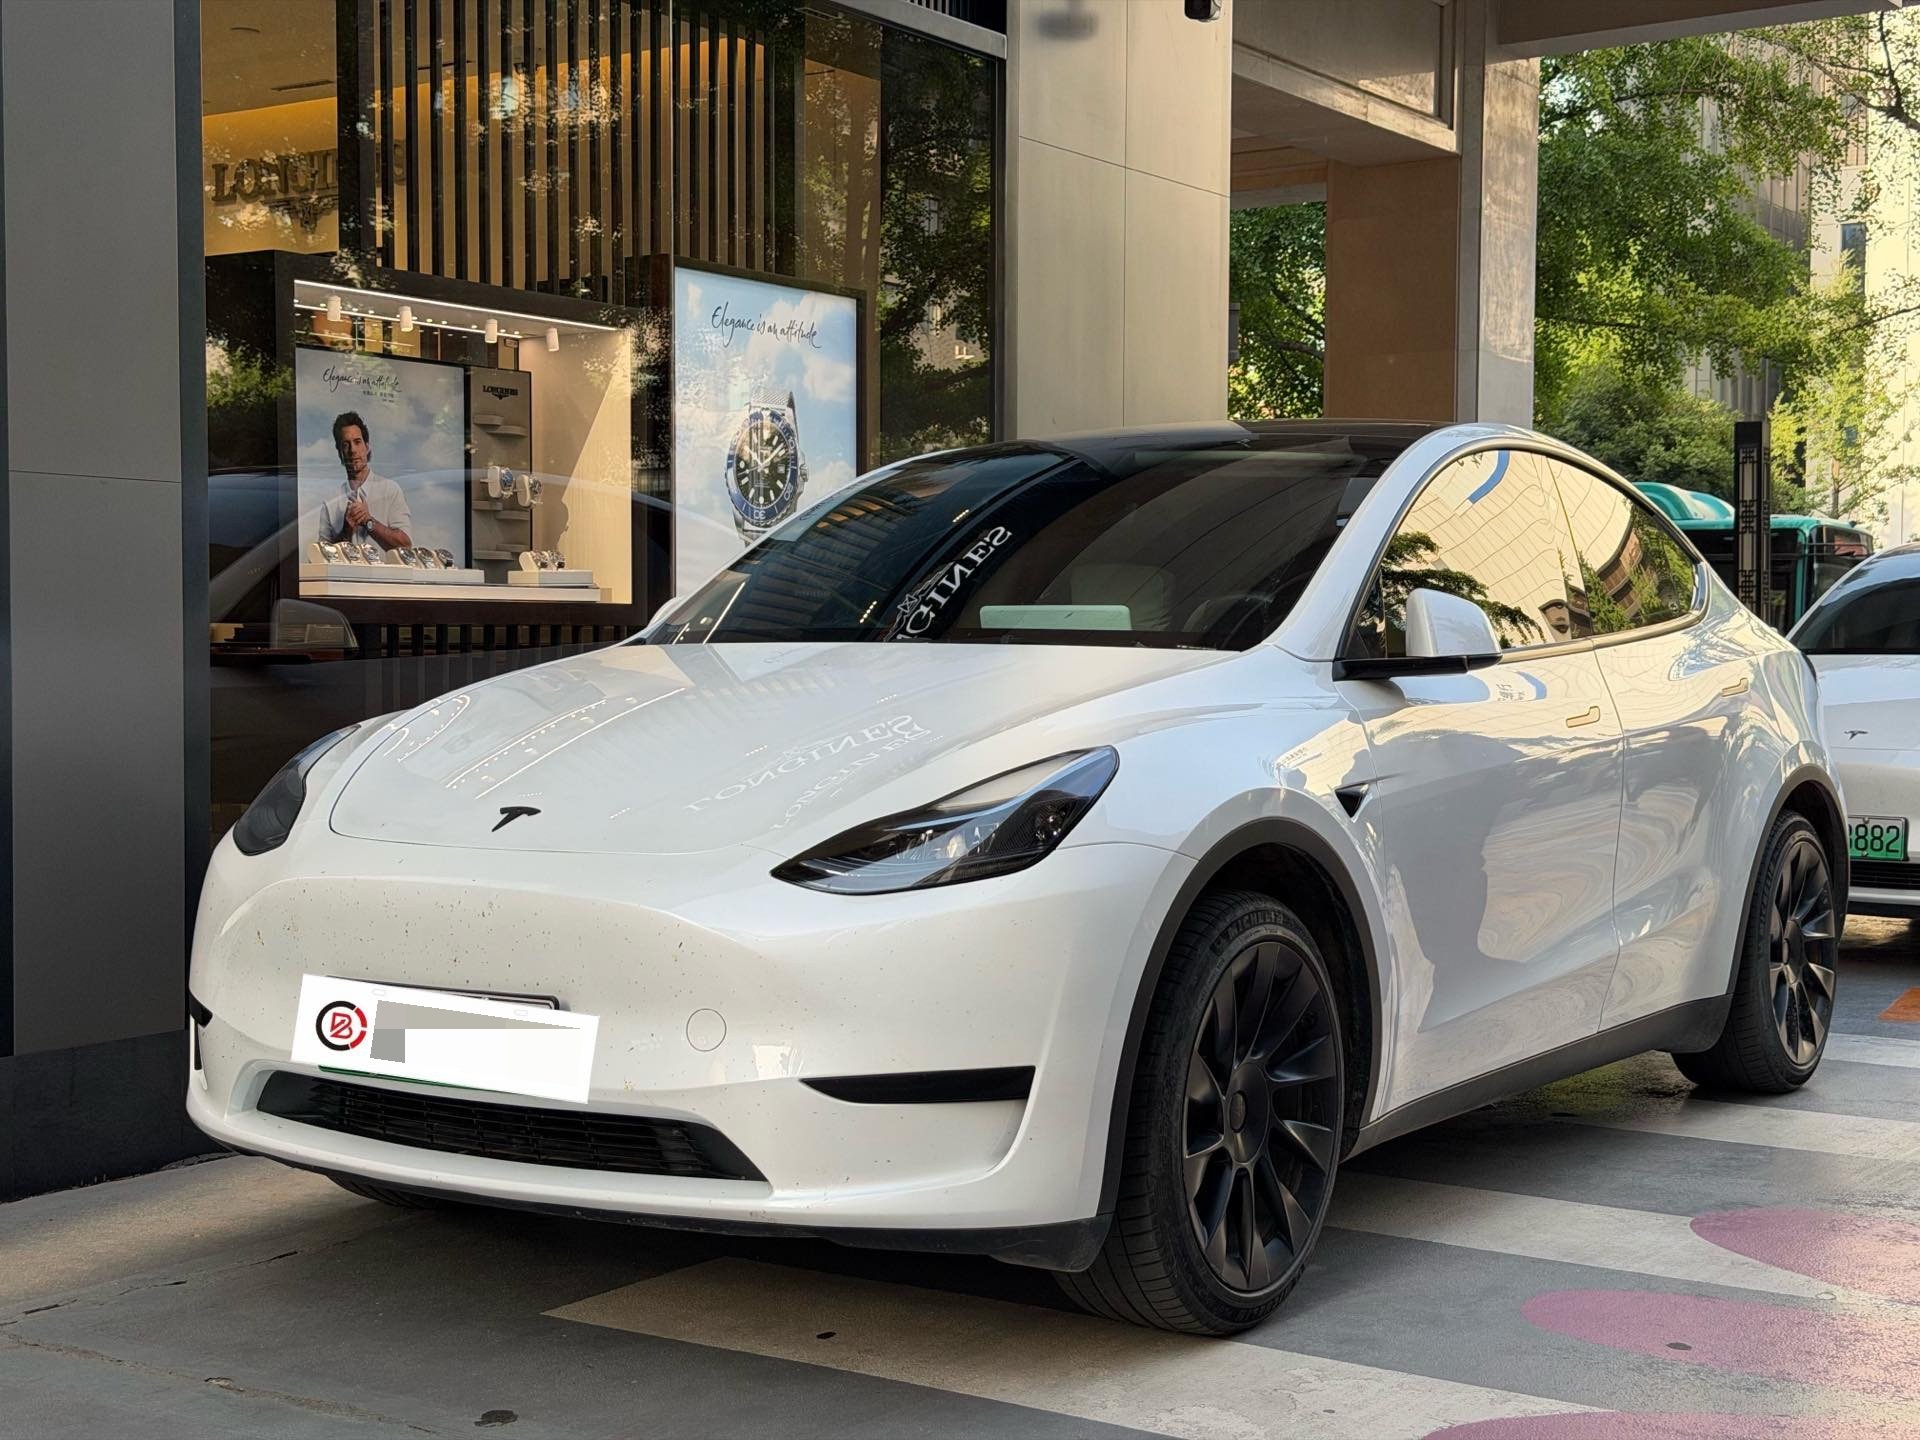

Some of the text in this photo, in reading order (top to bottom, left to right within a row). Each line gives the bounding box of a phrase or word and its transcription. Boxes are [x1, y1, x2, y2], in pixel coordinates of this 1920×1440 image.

[711, 301, 821, 348] Elegance is an attitude
